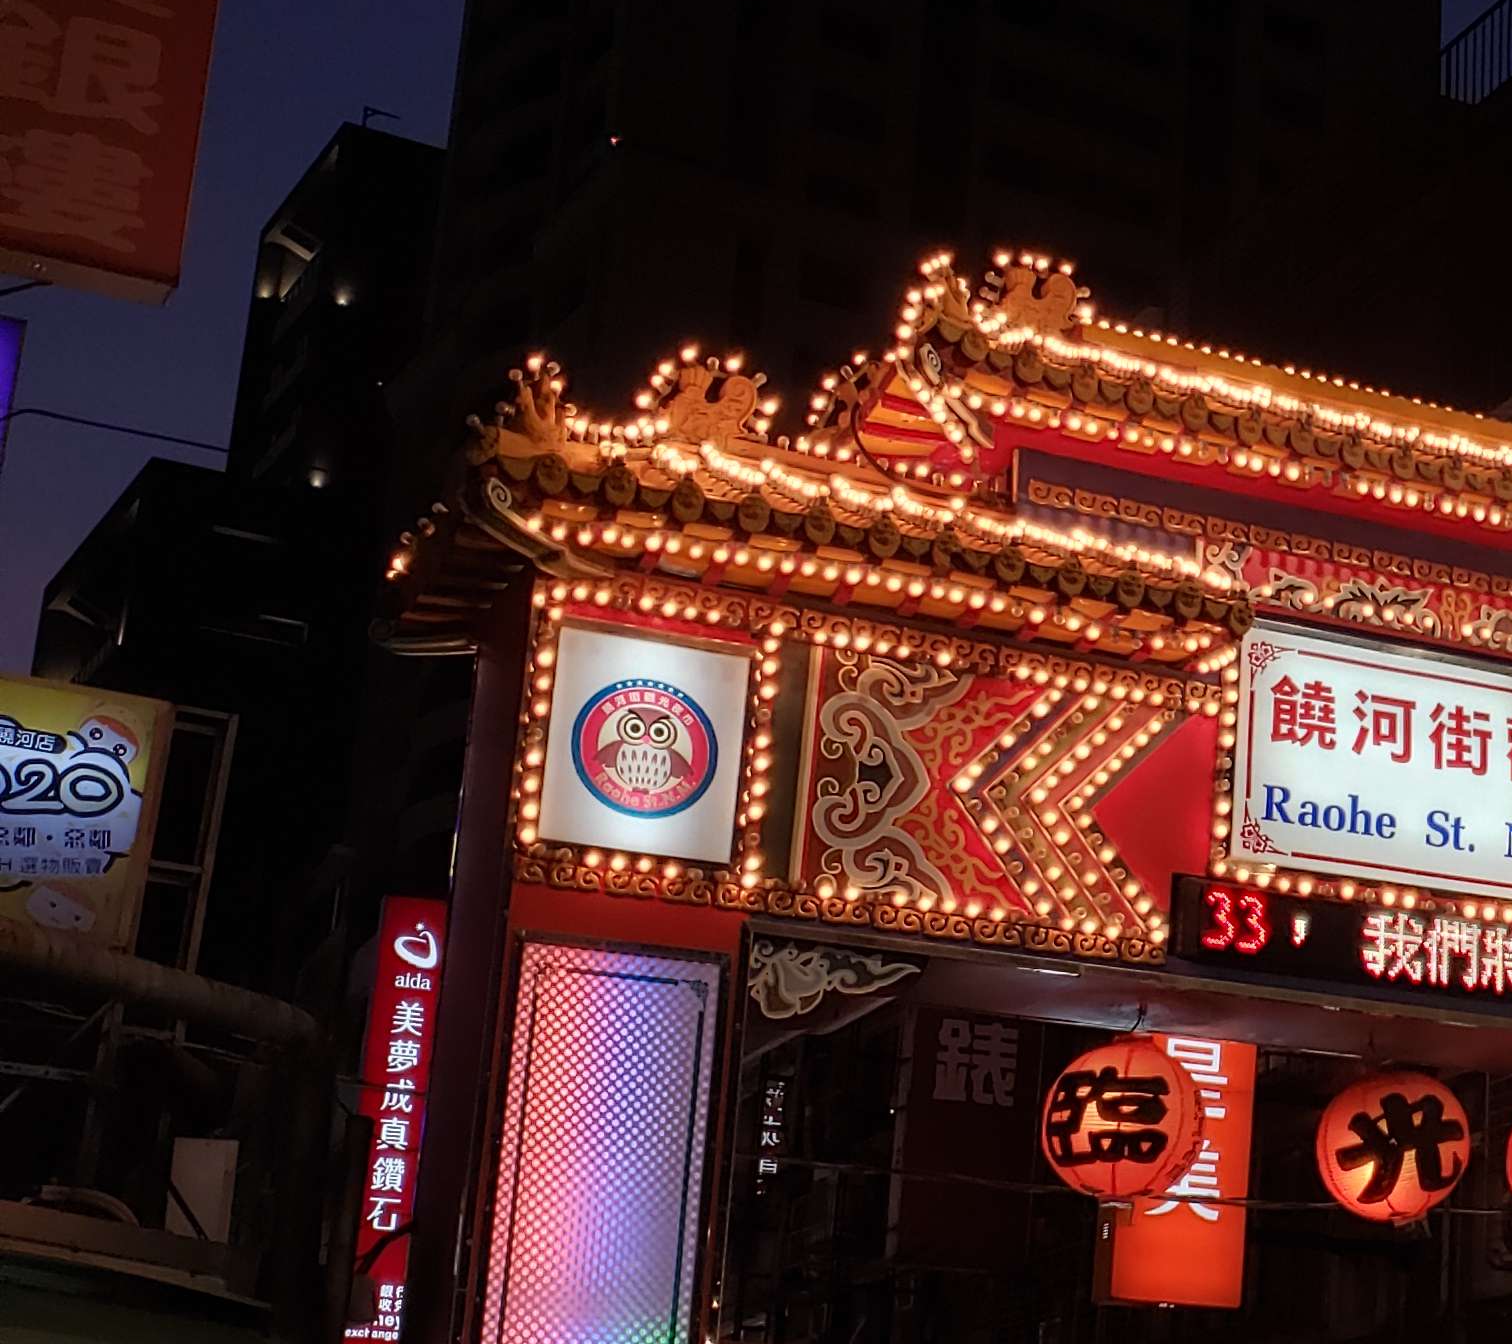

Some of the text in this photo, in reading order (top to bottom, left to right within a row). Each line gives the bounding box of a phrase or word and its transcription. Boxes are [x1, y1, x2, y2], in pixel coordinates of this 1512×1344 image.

[0, 758, 124, 818] 20
[1261, 784, 1397, 840] Raohe
[1425, 810, 1476, 854] St.
[1201, 888, 1270, 954] 33
[366, 1000, 425, 1233] 美夢成真鑽石
